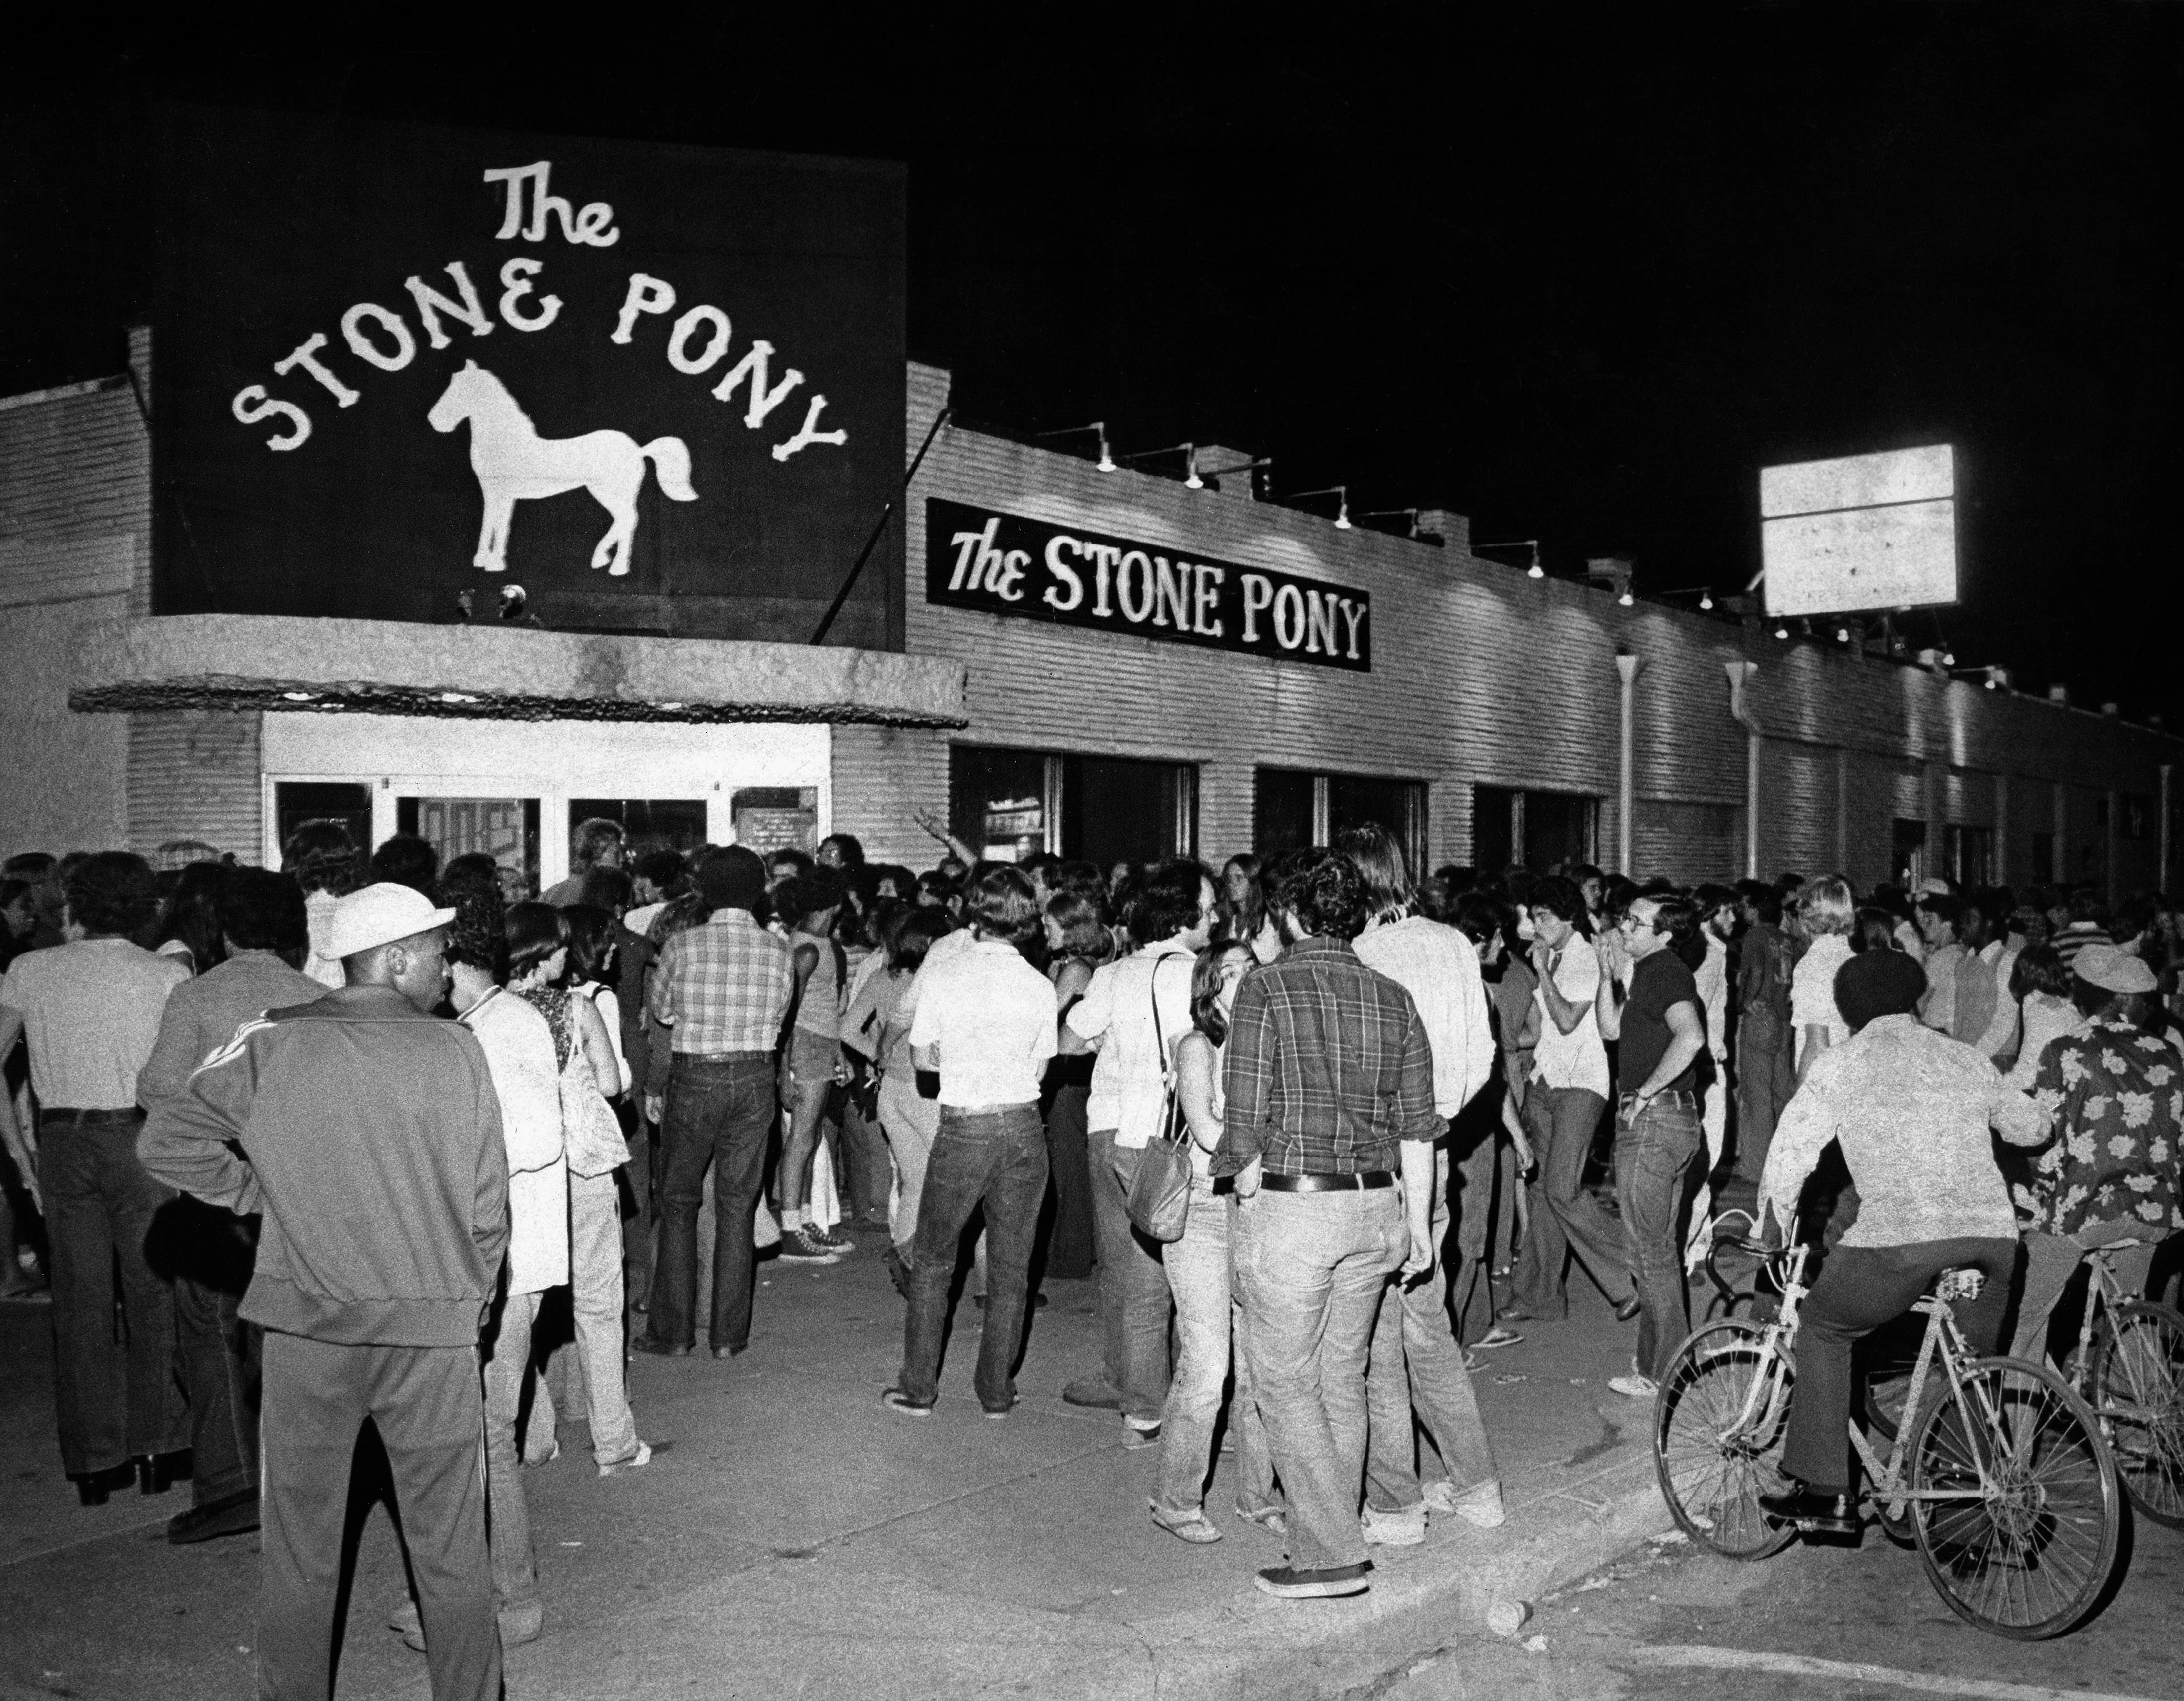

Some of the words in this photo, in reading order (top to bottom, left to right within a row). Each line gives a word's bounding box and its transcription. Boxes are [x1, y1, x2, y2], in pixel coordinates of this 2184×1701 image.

[484, 161, 619, 247] The
[232, 258, 564, 451] STONE
[610, 273, 848, 462] PONY
[947, 517, 1031, 601] The
[1042, 535, 1225, 638] STONE
[1241, 574, 1367, 660] PONY
